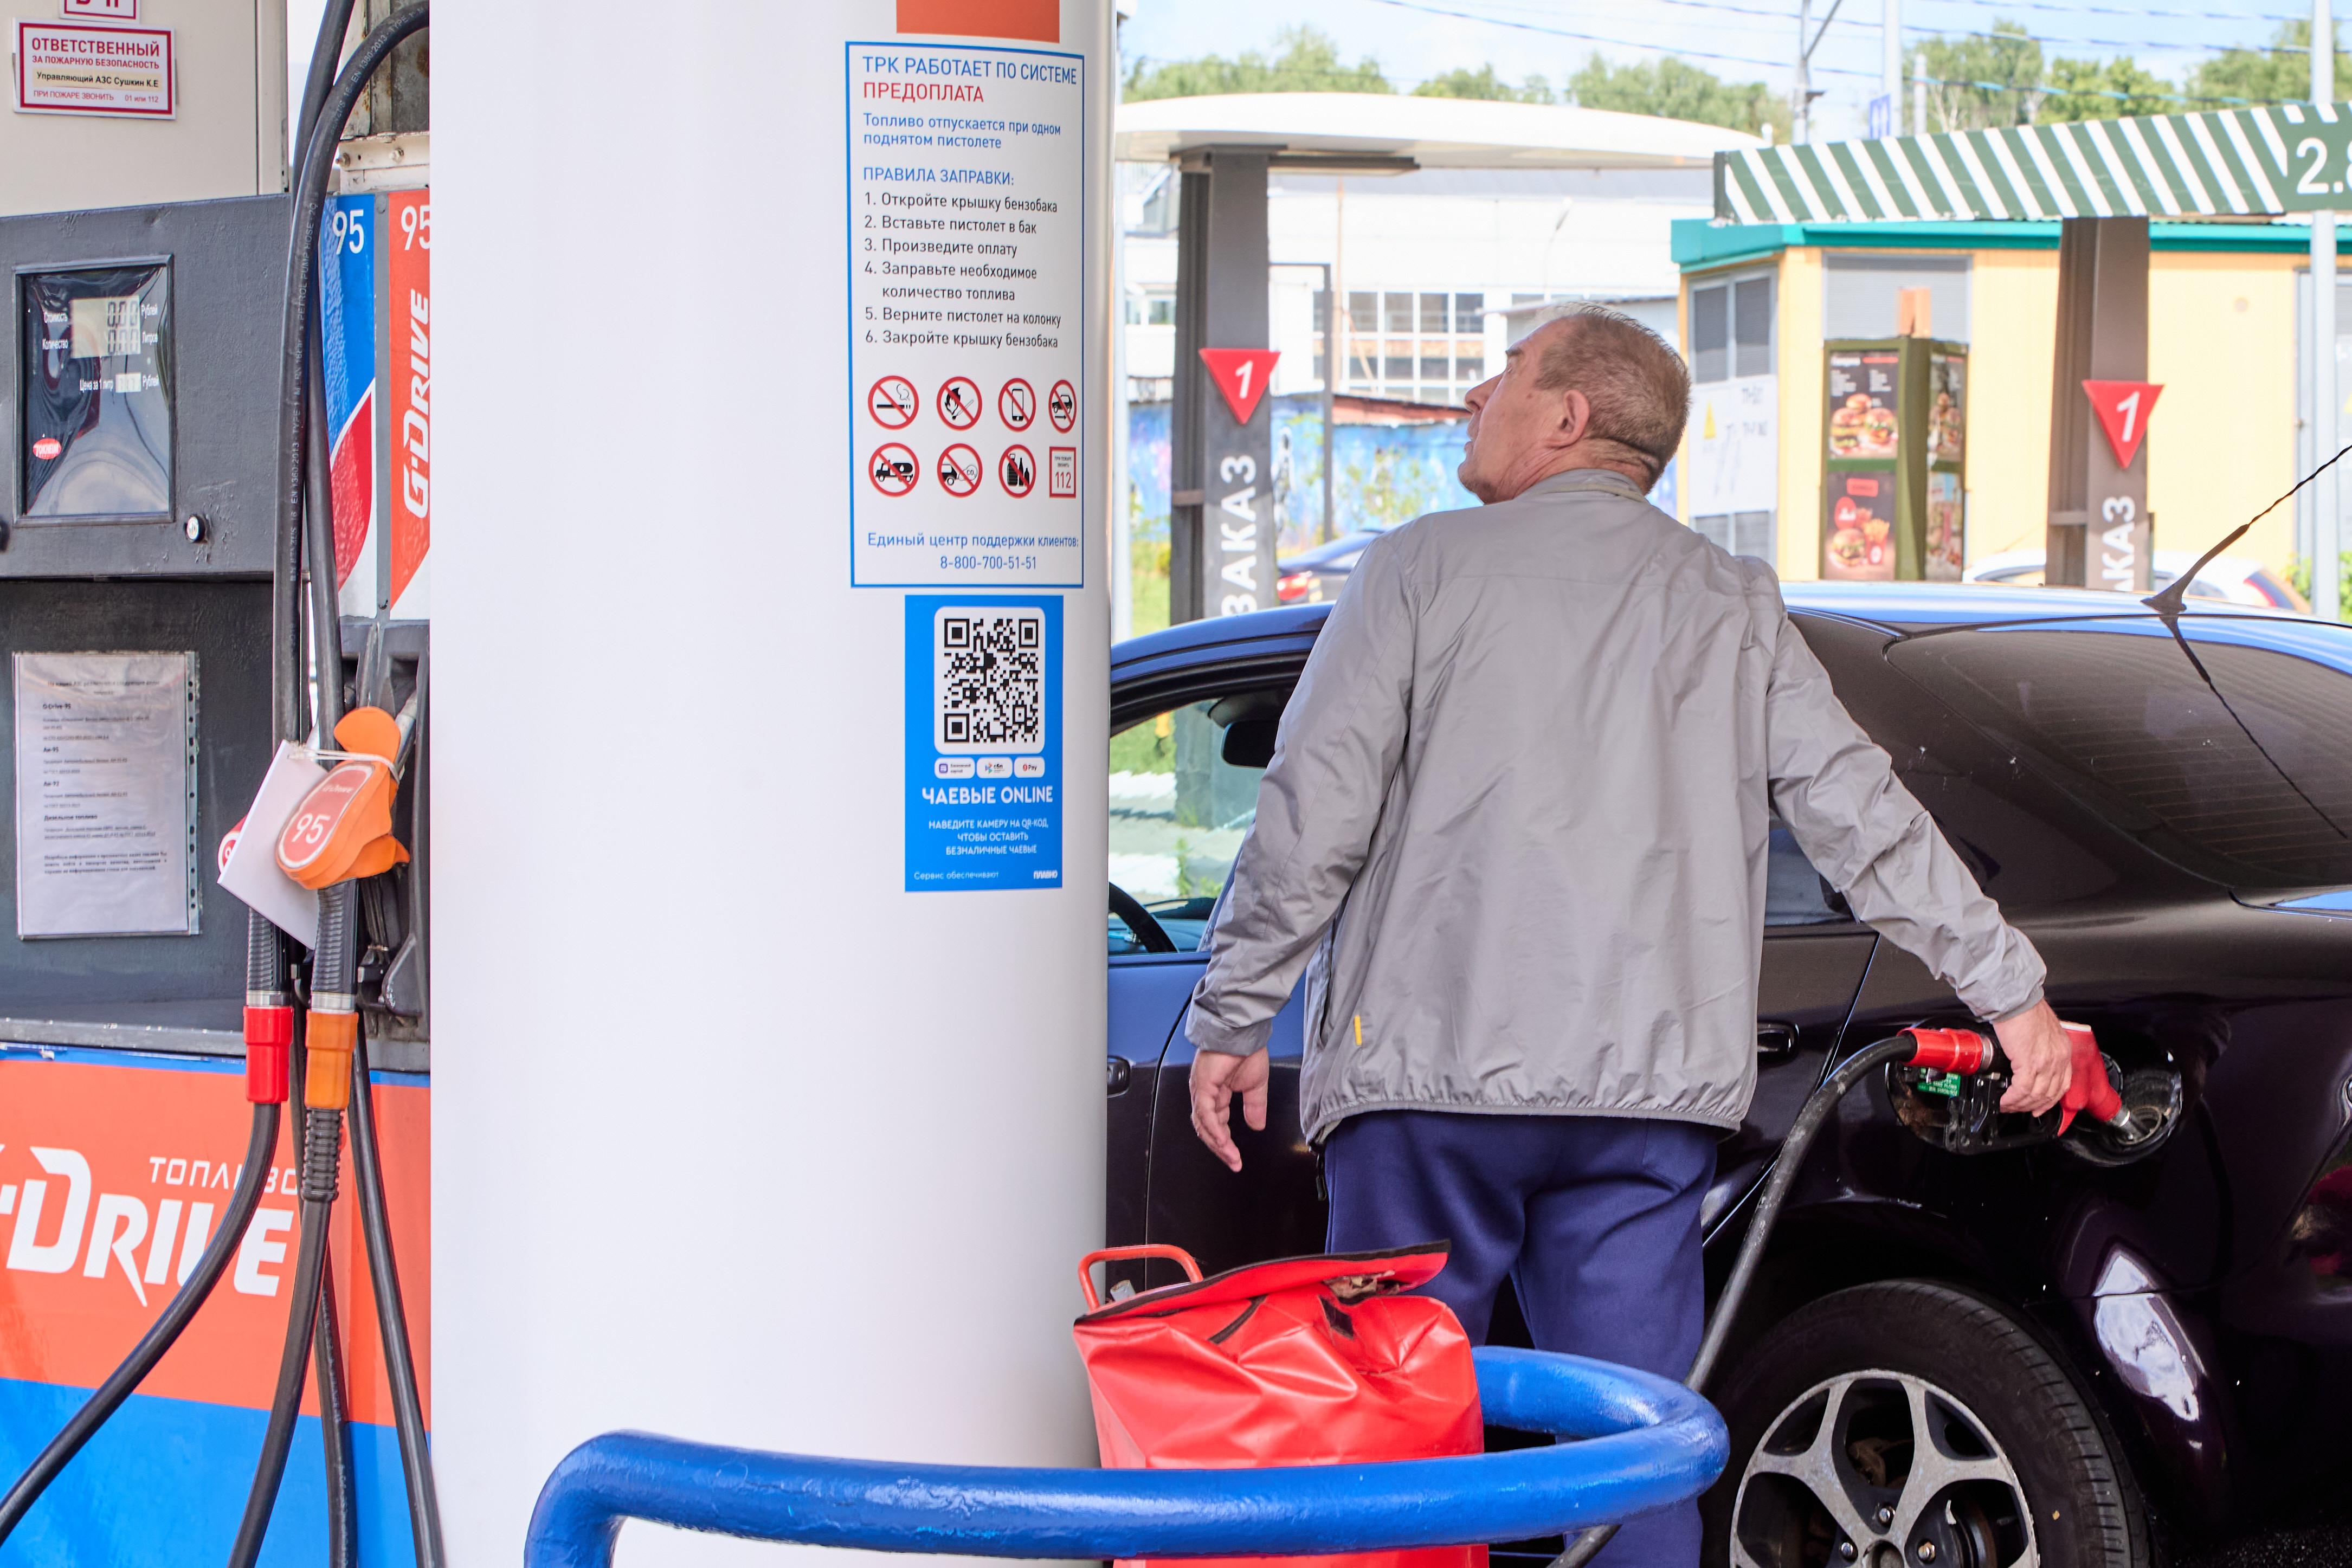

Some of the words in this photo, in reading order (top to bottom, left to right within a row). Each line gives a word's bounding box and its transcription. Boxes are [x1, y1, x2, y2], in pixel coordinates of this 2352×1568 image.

[32, 37, 159, 56] ОТВЕТСТВЕННЫЙ
[46, 56, 93, 66] ПОЖАРНУЮ
[95, 59, 159, 69] БЕЗОПАСНОСТЬ
[862, 56, 899, 74] ТРК
[905, 57, 991, 78] РАБОТАЕТ
[996, 62, 1016, 79] ПО
[1021, 63, 1077, 85] СИСТЕМЕ
[37, 72, 93, 83] Управляющий
[95, 76, 112, 84] АЗС
[114, 77, 144, 87] Сушкин
[352, 71, 362, 83] EN
[863, 82, 984, 102] ПРЕДОПЛАТА
[863, 113, 924, 127] Топливо
[929, 118, 1005, 132] отпускается
[1009, 121, 1028, 133] при
[1032, 124, 1061, 135] одном
[864, 134, 933, 147] поднятом
[938, 137, 1002, 149] пистолете
[2296, 137, 2352, 195] 2.
[863, 167, 936, 182] ПРАВИЛА
[940, 169, 1015, 185] ЗАПРАВКИ:
[865, 192, 876, 205] 1.
[881, 192, 947, 209] Откройте
[952, 197, 1001, 212] крышку
[1004, 197, 1058, 212] бензобака
[333, 209, 364, 255] 95
[402, 205, 430, 250] 95
[864, 215, 877, 229] 2.
[882, 216, 945, 230] Вставьте
[950, 220, 1006, 232] пистолет
[1009, 223, 1015, 233] в
[1019, 220, 1037, 234] бак
[304, 223, 314, 249] HOSE
[864, 238, 877, 251] 3.
[882, 238, 974, 255] Произведите
[977, 243, 1017, 258] оплату
[300, 250, 310, 279] PUMP
[865, 261, 877, 274] 4.
[882, 261, 956, 279] Заправьте
[960, 264, 1038, 280] необходимое
[298, 282, 307, 321] PETROL
[882, 286, 962, 299] количество
[966, 288, 1015, 301] топлива
[141, 304, 158, 319] Рублей
[865, 307, 878, 320] 5.
[883, 307, 943, 324] Верните
[947, 311, 1003, 323] пистолет
[1007, 313, 1020, 324] на
[1023, 313, 1061, 328] колонку
[42, 339, 68, 350] Количество
[142, 332, 158, 343] Литров
[865, 330, 878, 343] 6.
[882, 330, 949, 347] Закройте
[953, 334, 1002, 349] крышку
[1006, 333, 1058, 348] бензобака
[80, 379, 92, 391] Цена
[143, 375, 159, 388] Рублей
[1235, 360, 1253, 399] 1
[2116, 391, 2140, 442] 1
[1055, 472, 1071, 488] 112
[291, 491, 298, 504] EN
[868, 532, 924, 546] Единый
[930, 535, 968, 550] центр
[972, 536, 1035, 549] поддержки
[1039, 538, 1079, 547] клиентов:
[1220, 454, 1257, 617] ЗАКАЗ
[2102, 495, 2136, 592] КАЗ
[940, 556, 1036, 570] 8-800-700-51-51
[922, 786, 996, 805] ЧАЕВЫЕ
[1001, 785, 1053, 804] ONLINE
[291, 813, 331, 844] 95
[929, 820, 974, 830] НАВЕДИТЕ
[977, 819, 1008, 828] КАМЕРУ
[1010, 819, 1020, 827] НА
[1022, 818, 1048, 829] QR-КОД,
[957, 833, 987, 841] ЧТОБЫ
[989, 832, 1028, 841] ОСТАВИТЬ
[946, 846, 1007, 855] БЕЗНАЛИЧНЫЕ
[1009, 845, 1036, 854] ЧАЕВЫЕ
[914, 872, 944, 880] Сервис
[946, 871, 998, 879] обеспечивают
